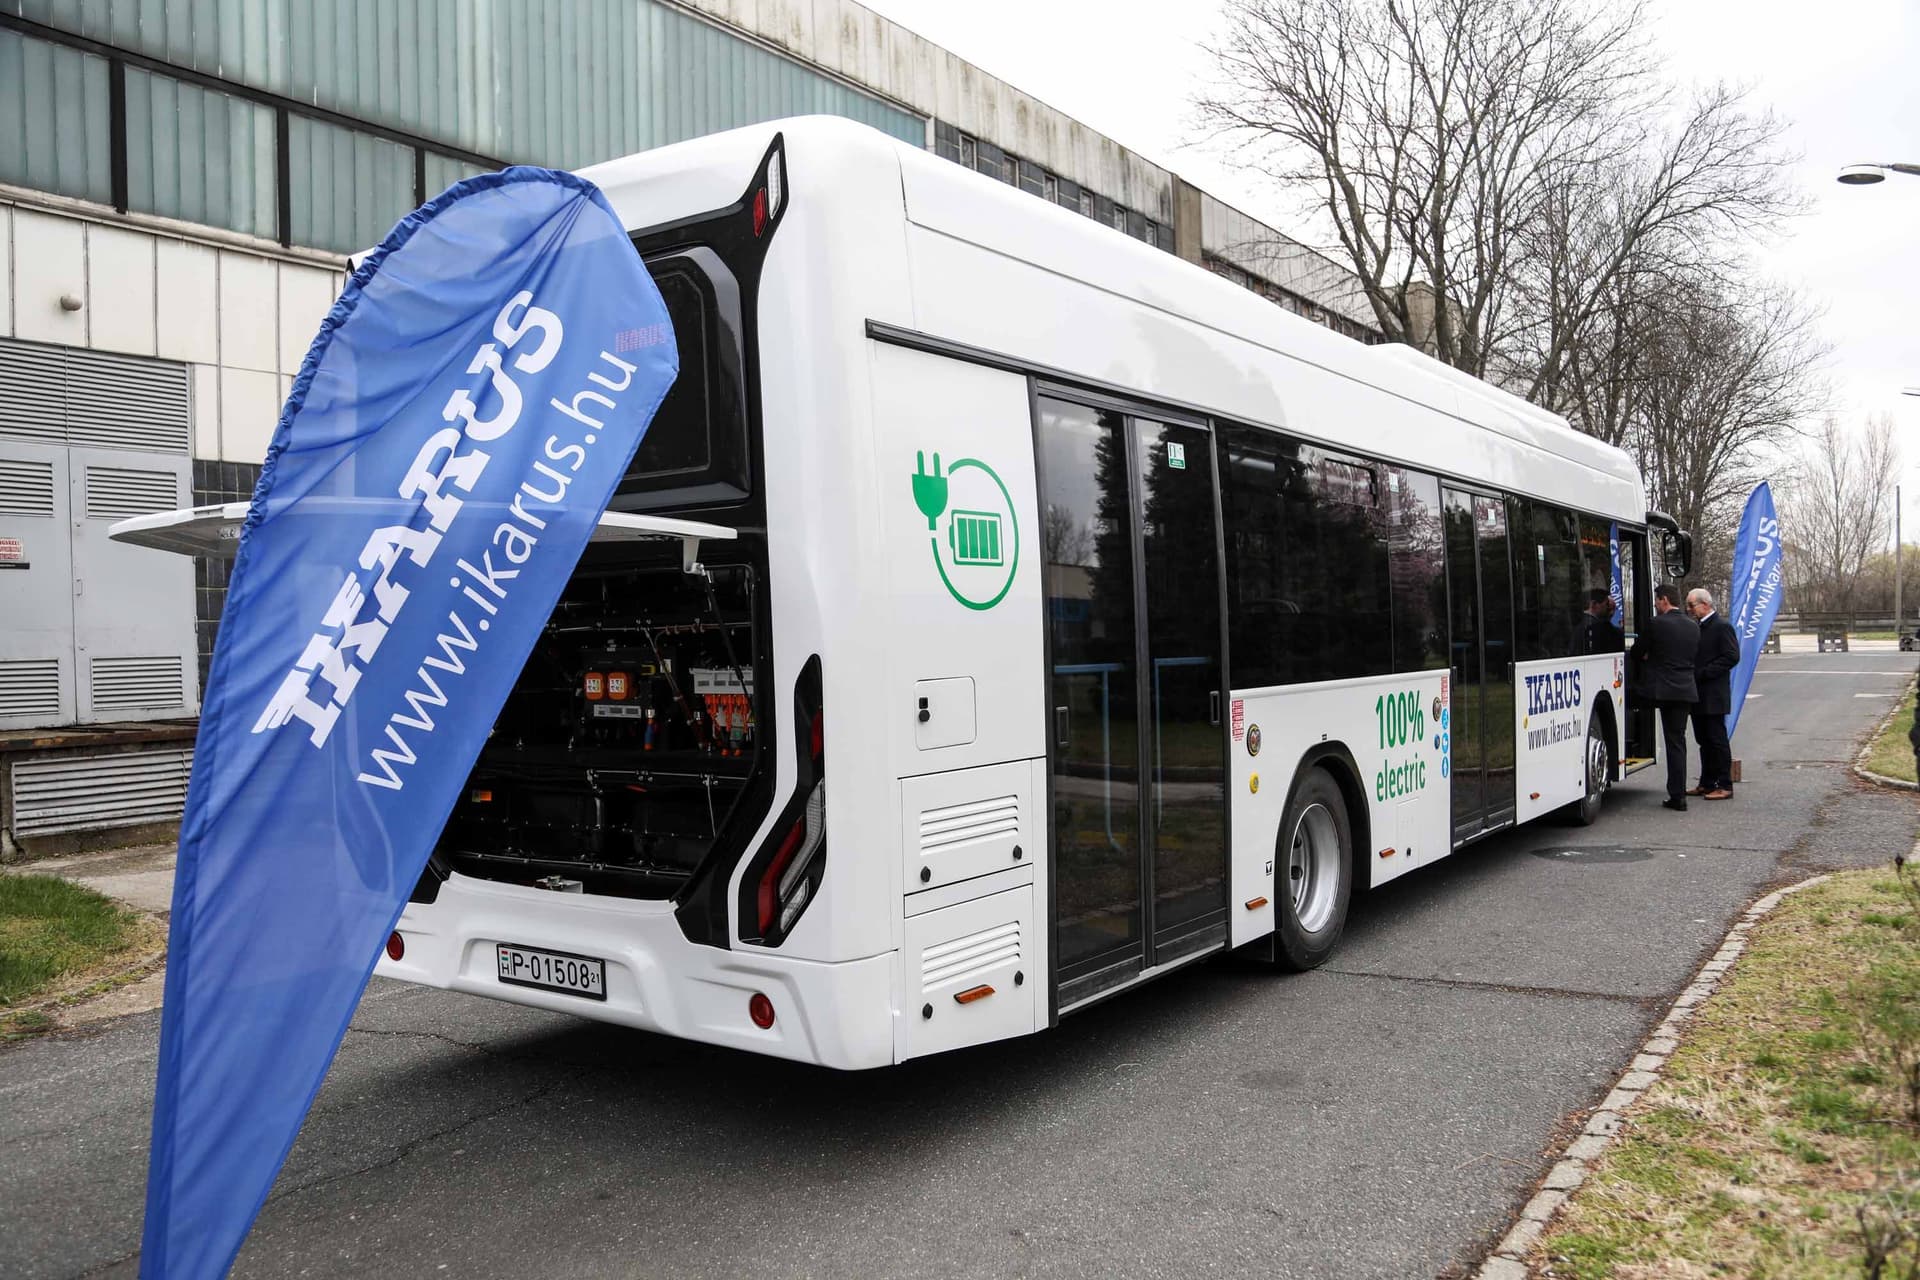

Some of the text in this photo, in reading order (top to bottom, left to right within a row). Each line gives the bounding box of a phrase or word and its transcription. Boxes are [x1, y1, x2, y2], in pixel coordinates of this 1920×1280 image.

[251, 290, 564, 749] IKARUS
[357, 350, 639, 790] www.ikarus.hu
[1525, 669, 1581, 716] IKARUS
[1375, 690, 1425, 750] 100%
[1527, 713, 1582, 751] www.ikarus.hu
[1376, 752, 1426, 803] electric
[501, 951, 600, 989] H P-01508 21
